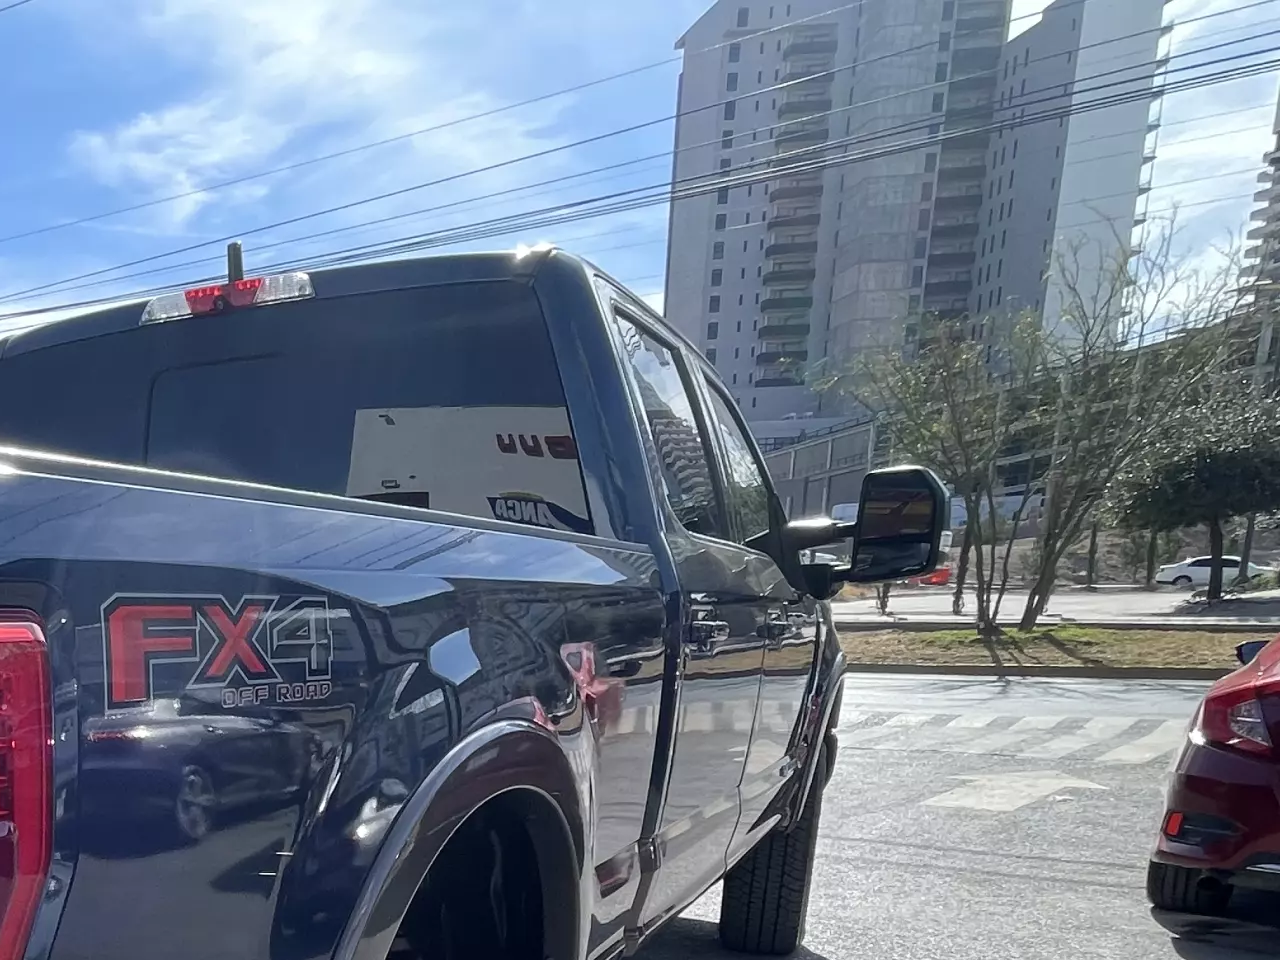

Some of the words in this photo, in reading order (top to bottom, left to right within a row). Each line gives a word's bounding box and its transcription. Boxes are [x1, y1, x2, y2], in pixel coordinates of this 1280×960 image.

[100, 592, 334, 716] FX4
[221, 684, 269, 709] OFF
[276, 680, 333, 703] ROAD
